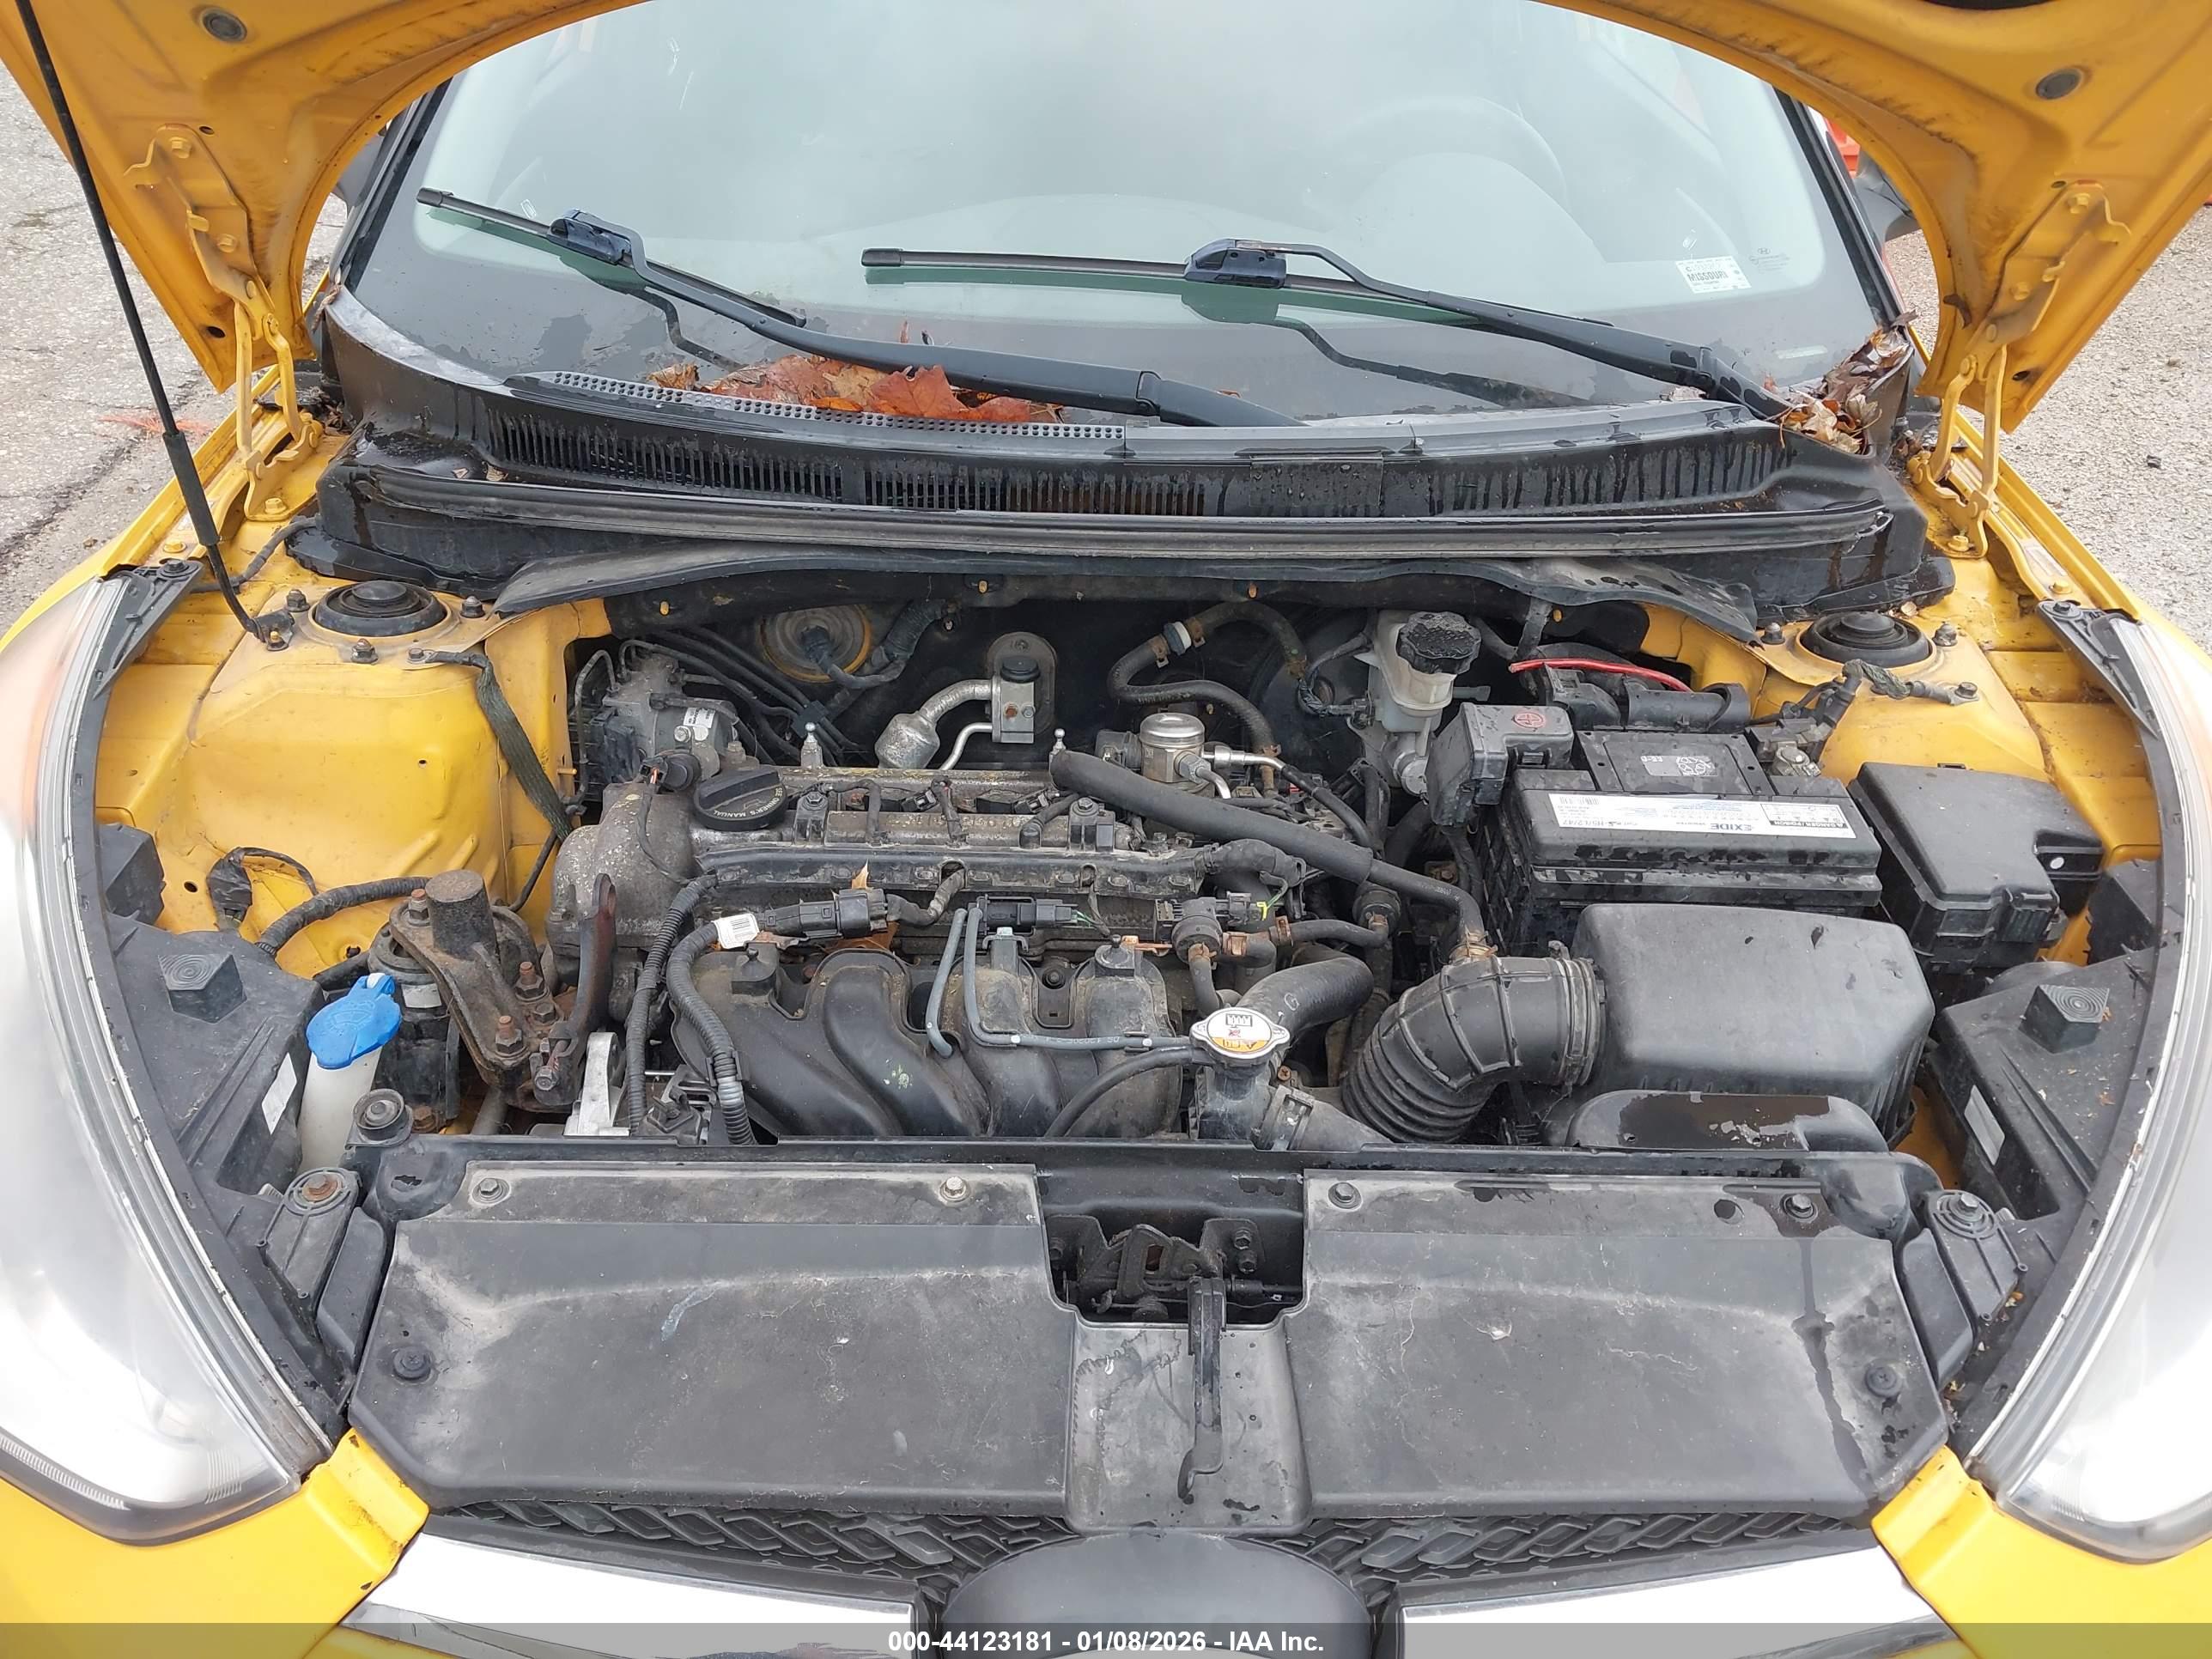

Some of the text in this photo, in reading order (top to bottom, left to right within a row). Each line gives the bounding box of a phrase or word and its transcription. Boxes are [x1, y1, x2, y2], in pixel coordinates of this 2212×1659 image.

[1686, 270, 1729, 283] MISSOURI
[749, 797, 780, 816] OWNER'S
[713, 810, 746, 818] MANUAL
[1710, 823, 1753, 831] EXIDE
